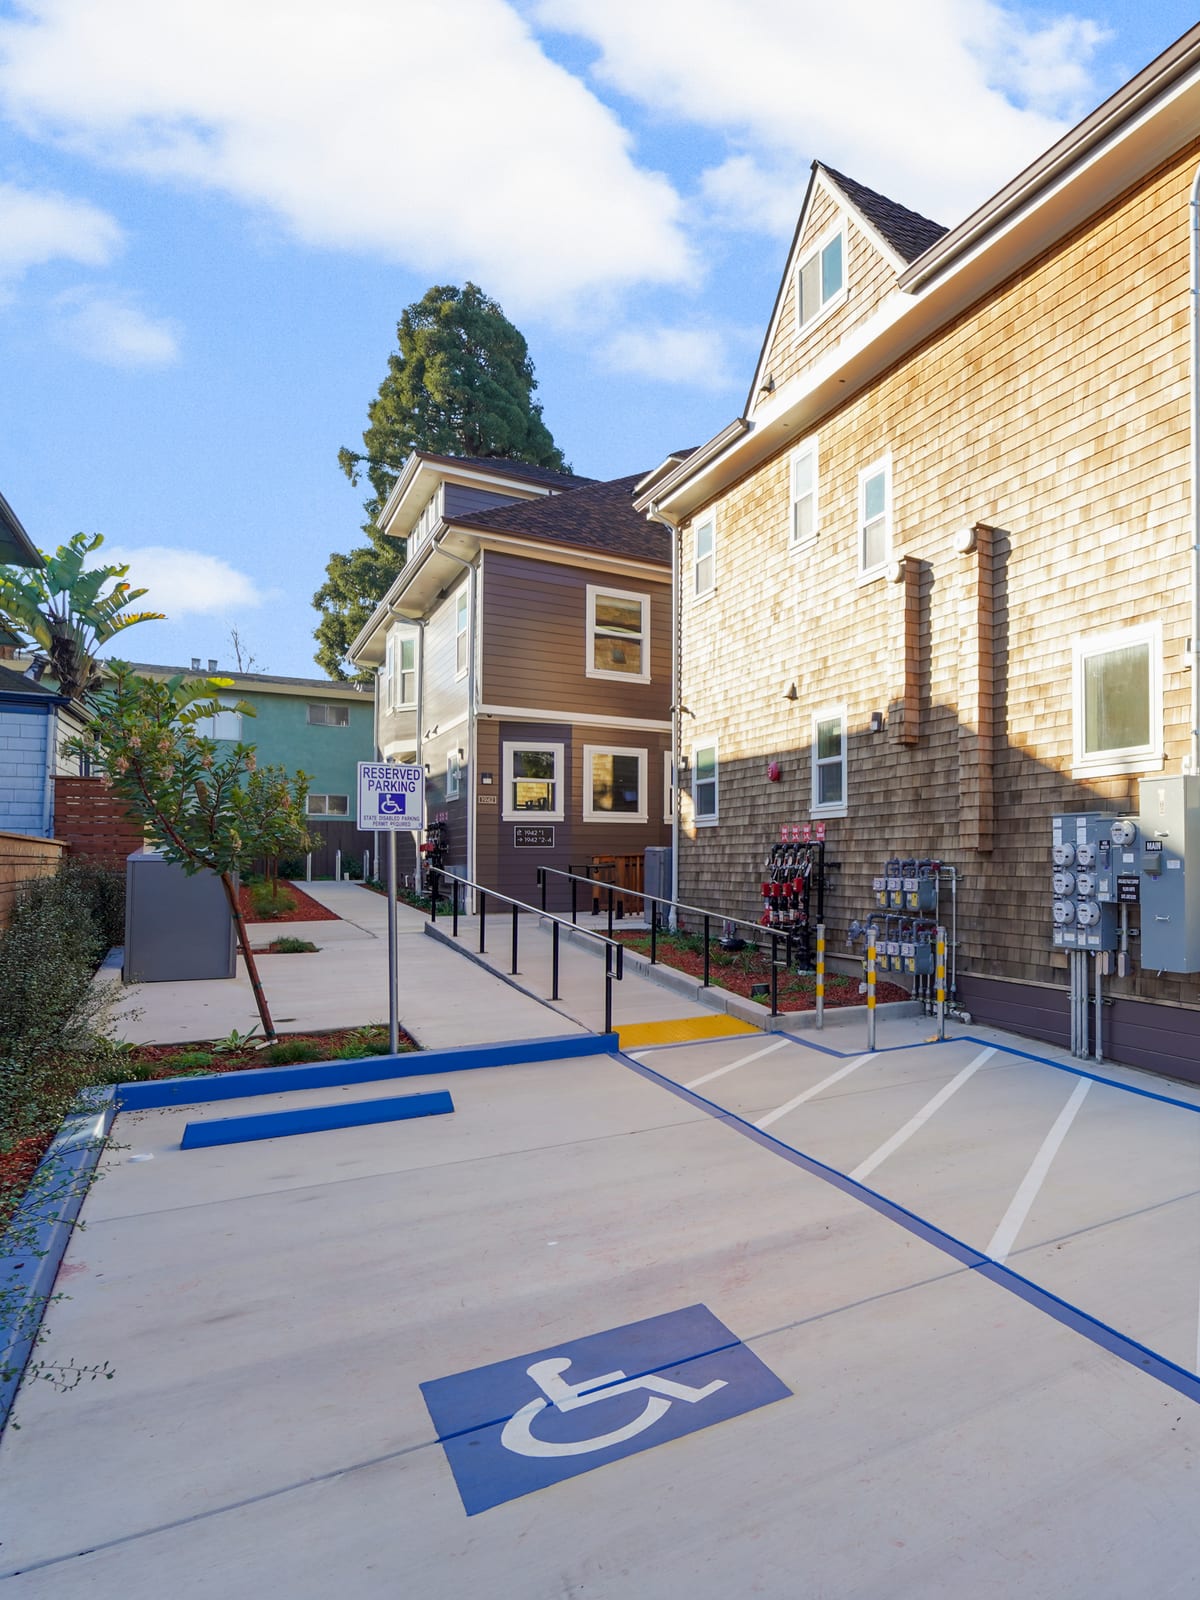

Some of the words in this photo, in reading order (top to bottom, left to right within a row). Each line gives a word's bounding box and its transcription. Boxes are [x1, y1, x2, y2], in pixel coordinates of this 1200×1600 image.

[363, 767, 421, 780] RESERVED
[368, 780, 416, 793] PARKING
[1146, 842, 1161, 850] MAIN
